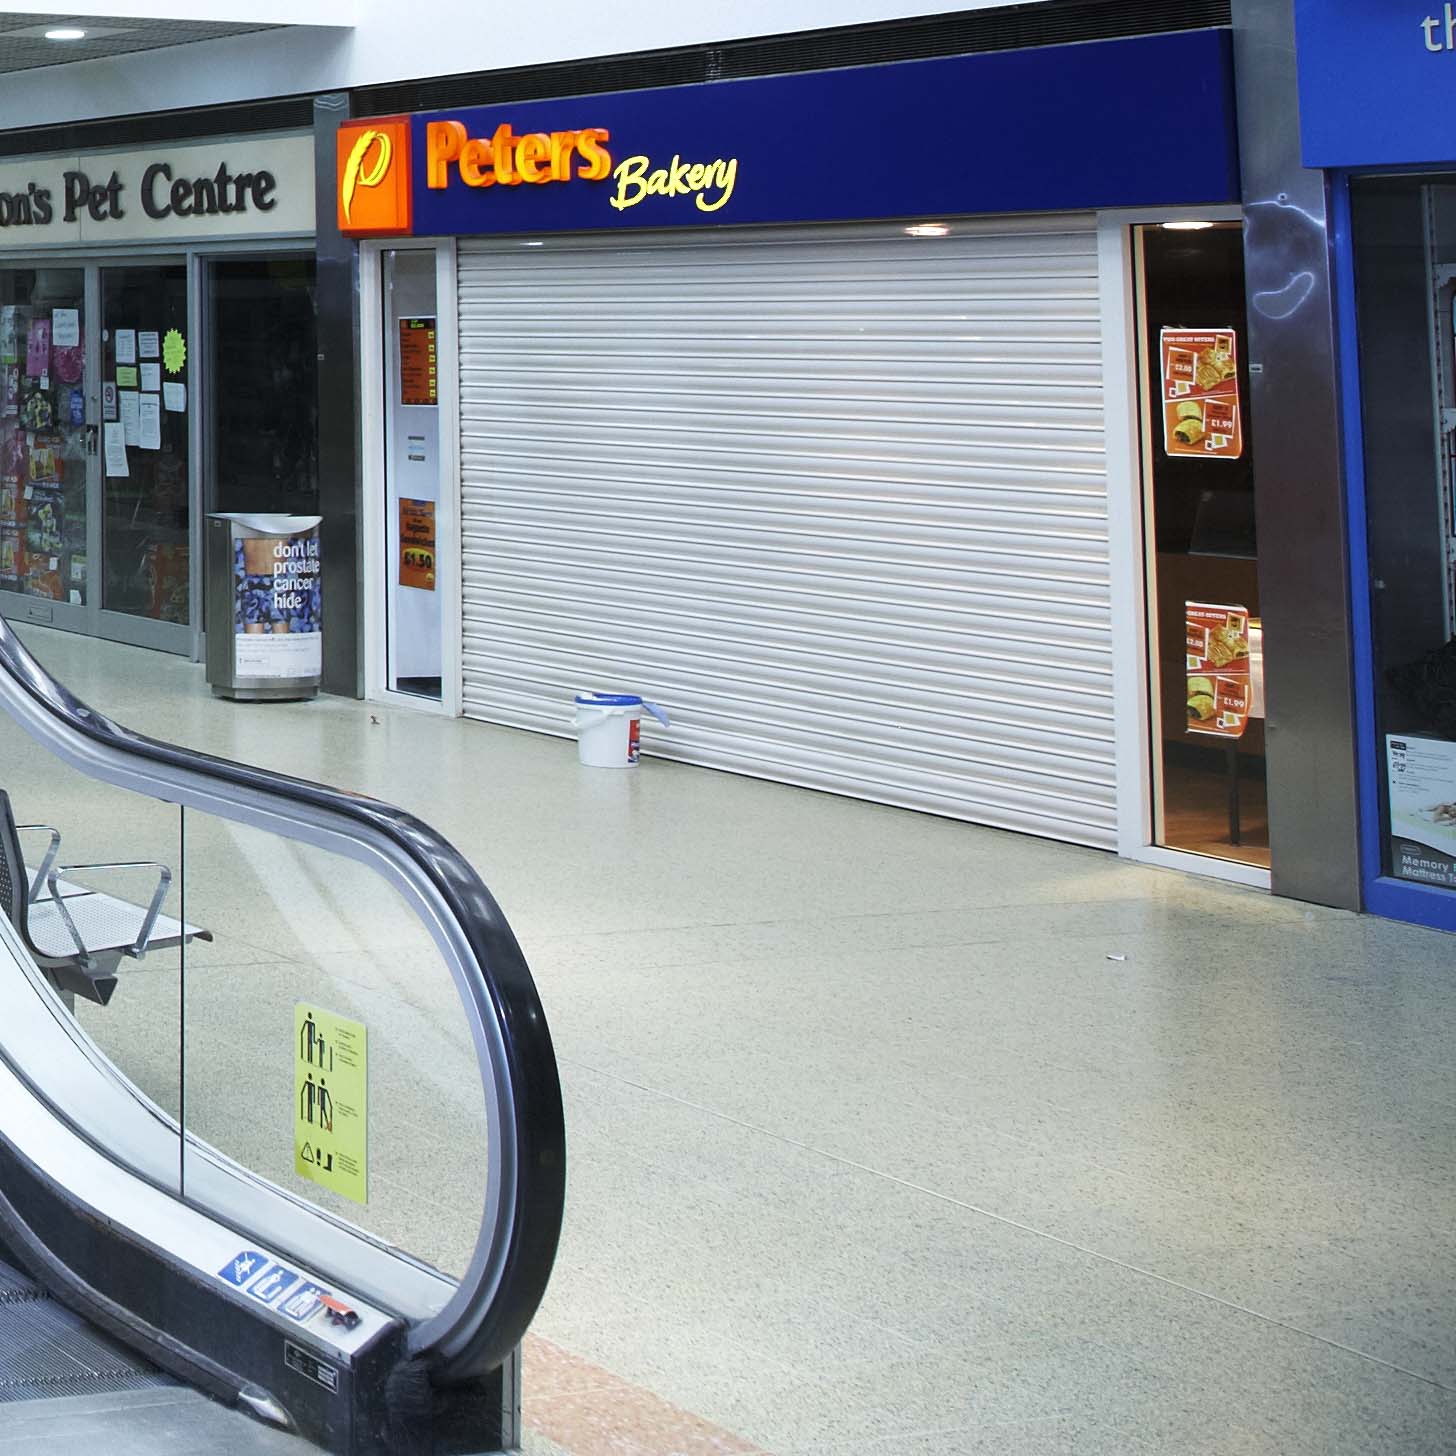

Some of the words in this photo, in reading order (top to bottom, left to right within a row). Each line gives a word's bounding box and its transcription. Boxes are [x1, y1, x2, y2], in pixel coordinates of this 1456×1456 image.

[426, 120, 611, 189] Peters
[62, 170, 125, 222] Pet
[141, 161, 277, 219] Centre
[609, 154, 738, 212] Bakery
[273, 541, 305, 558] don't
[307, 542, 319, 557] let
[273, 559, 320, 578] prostate
[273, 577, 314, 590] cancer
[273, 594, 302, 609] hide
[1401, 855, 1449, 872] Memory
[1401, 865, 1446, 882] Mattress
